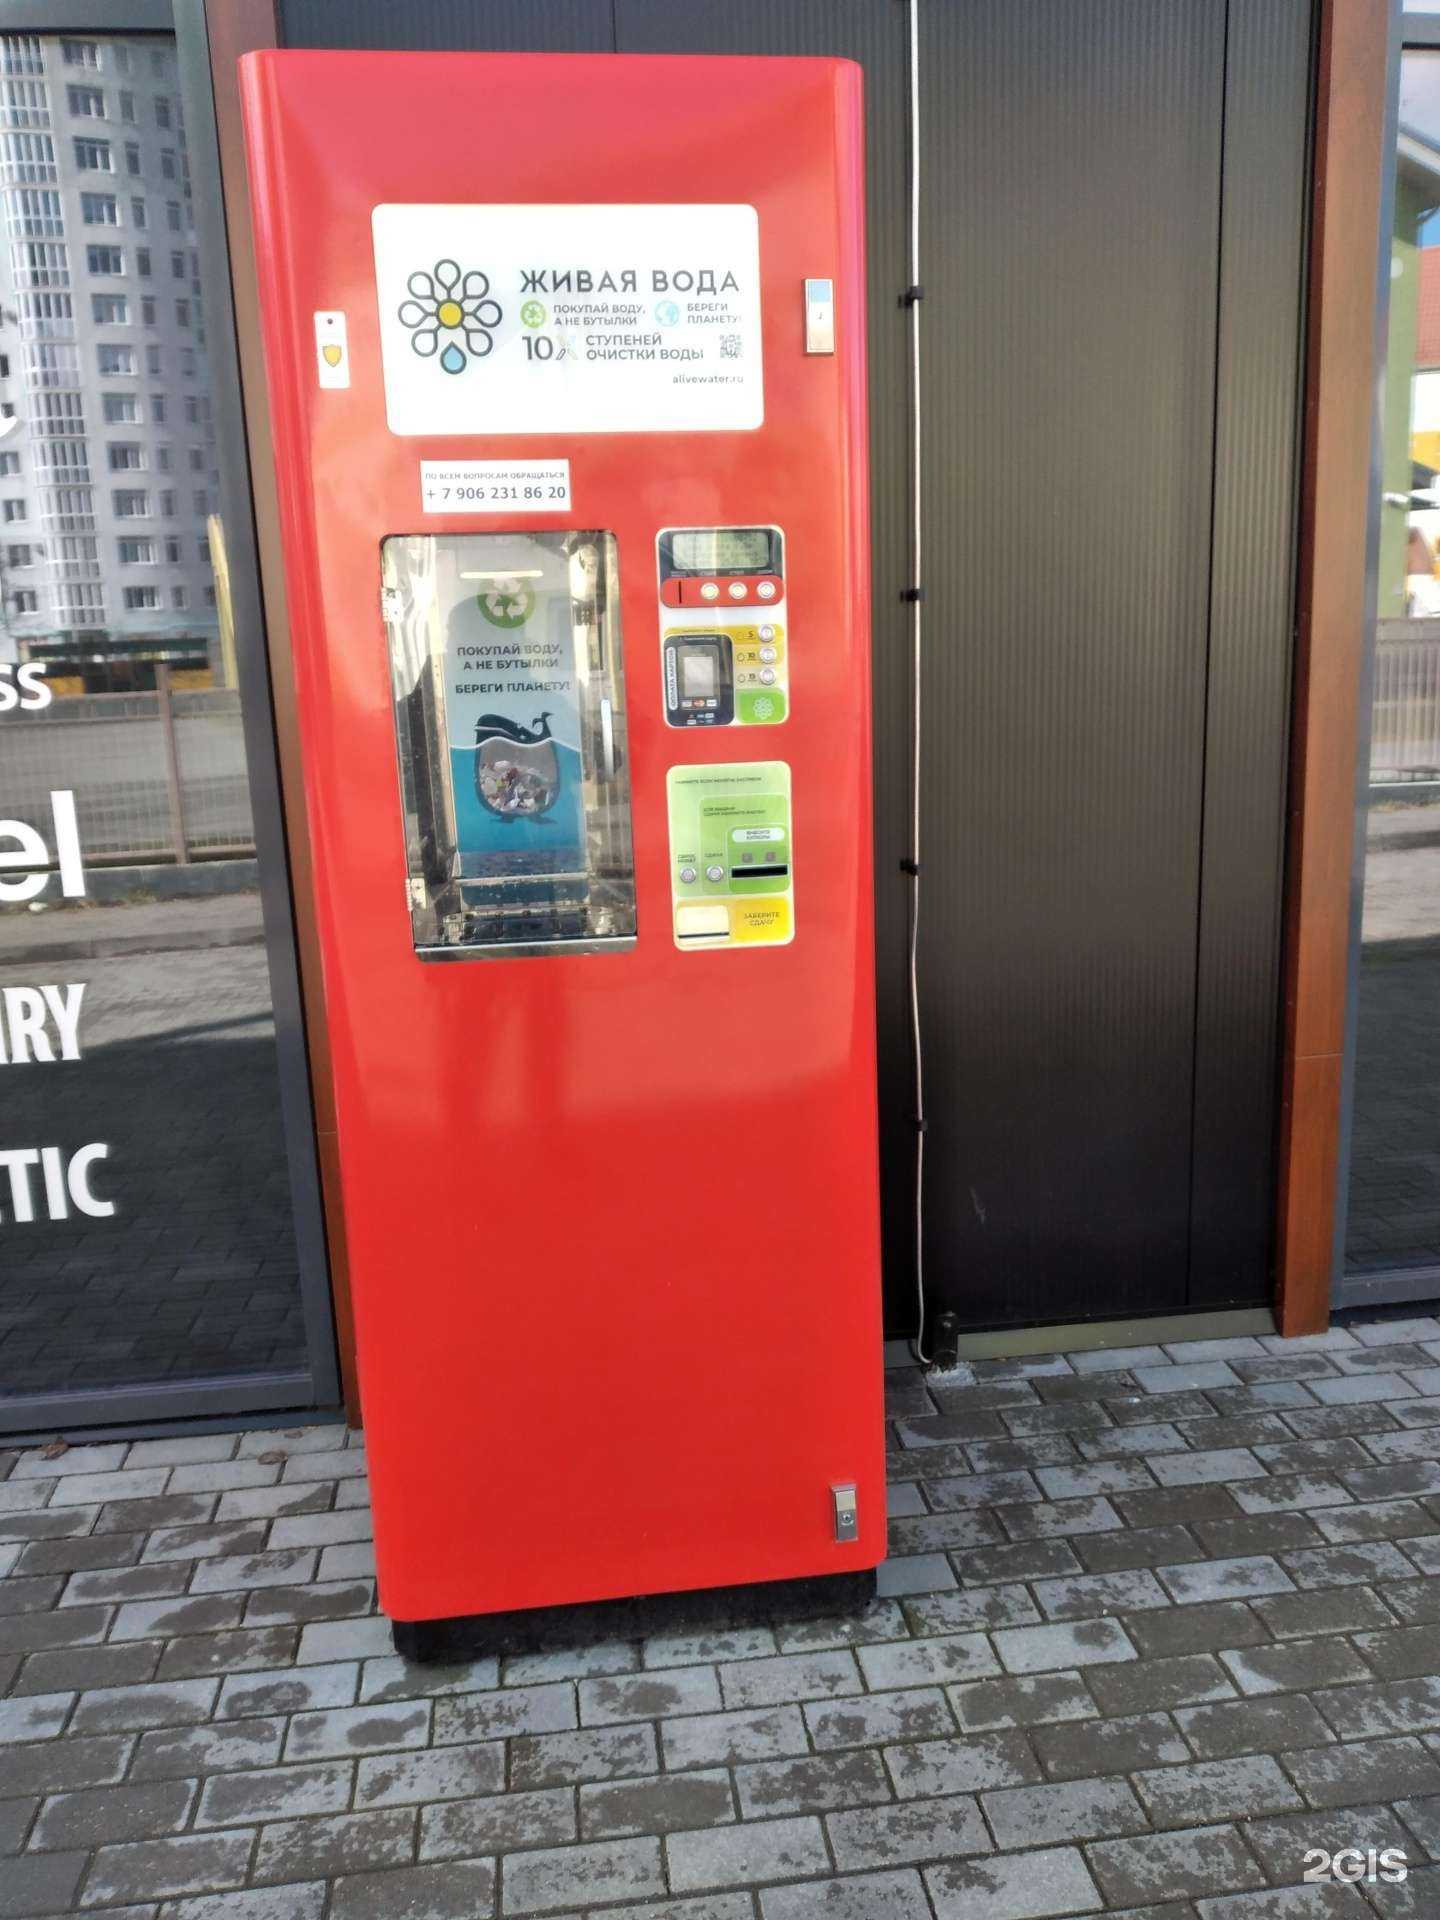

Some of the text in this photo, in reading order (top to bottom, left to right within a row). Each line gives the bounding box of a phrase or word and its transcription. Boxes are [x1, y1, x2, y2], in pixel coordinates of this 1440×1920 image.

[520, 269, 740, 296] ЖИВАЯ ВОДА
[553, 302, 646, 315] ПОКУПАЙ ВОДУ,
[687, 302, 728, 312] БЕРЕГИ
[554, 316, 637, 326] А НЕ БУТЫЛКИ
[586, 333, 662, 346] СТУПЕНЕЙ
[521, 335, 554, 361] 10
[586, 348, 704, 361] ОЧИСТКИ ВОДЫ
[672, 373, 744, 385] alivewater.ru
[442, 487, 451, 500] 7
[456, 487, 485, 500] 906
[490, 487, 517, 499] 231
[523, 486, 543, 499] 86
[548, 486, 566, 498] 20
[457, 643, 563, 656] ПОКУПАЙ ВОДУ,
[463, 659, 559, 670] А НЕ БУТЫЛКИ
[455, 681, 570, 694] БЕРЕГИ ПЛАНЕТУ!
[0, 983, 87, 1064] RY
[0, 1142, 115, 1223] TIC
